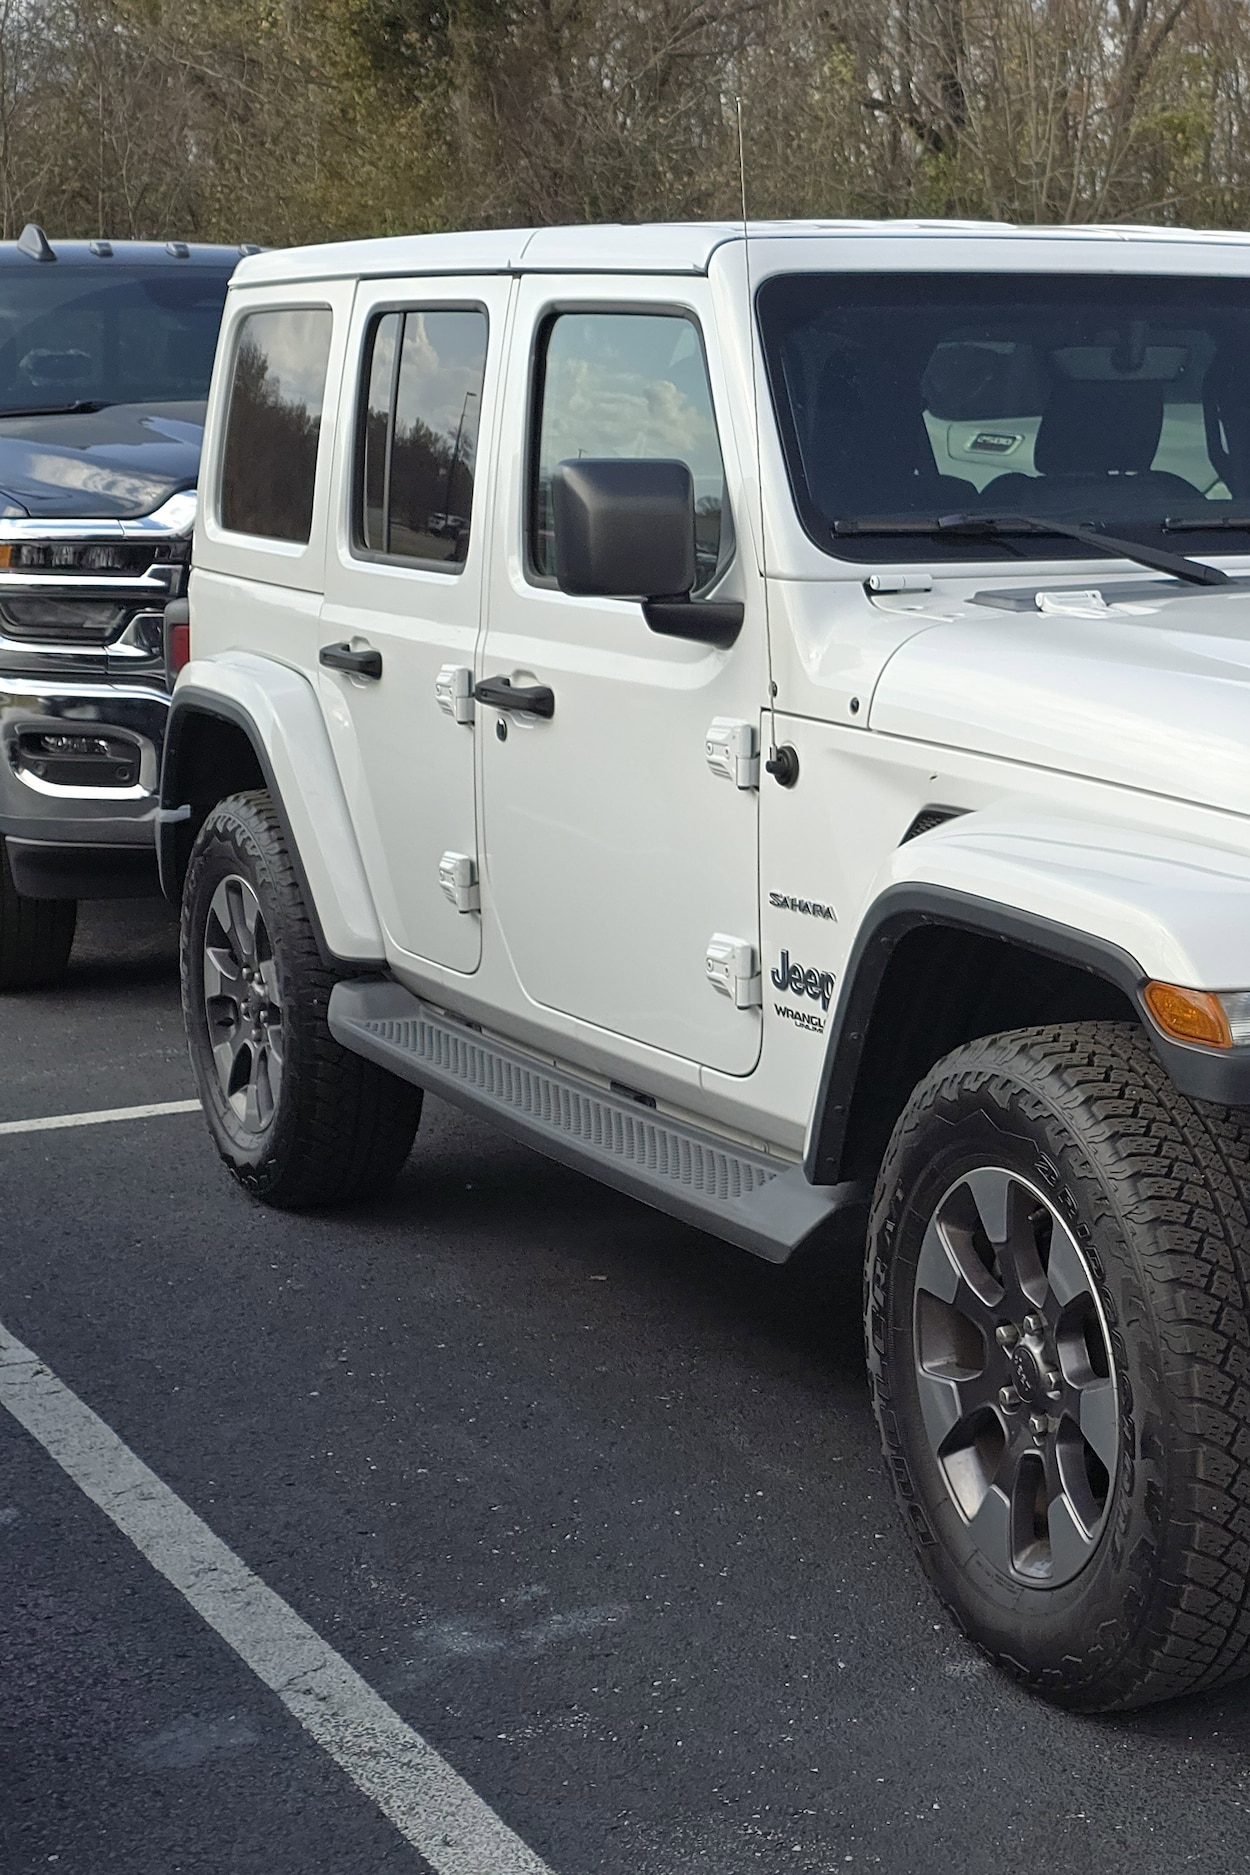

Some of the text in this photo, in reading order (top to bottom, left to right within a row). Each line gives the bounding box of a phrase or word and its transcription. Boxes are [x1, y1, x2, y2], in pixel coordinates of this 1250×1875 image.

[769, 892, 838, 922] SAHARA
[771, 949, 837, 1013] Jeep
[774, 1003, 826, 1028] WRANGL
